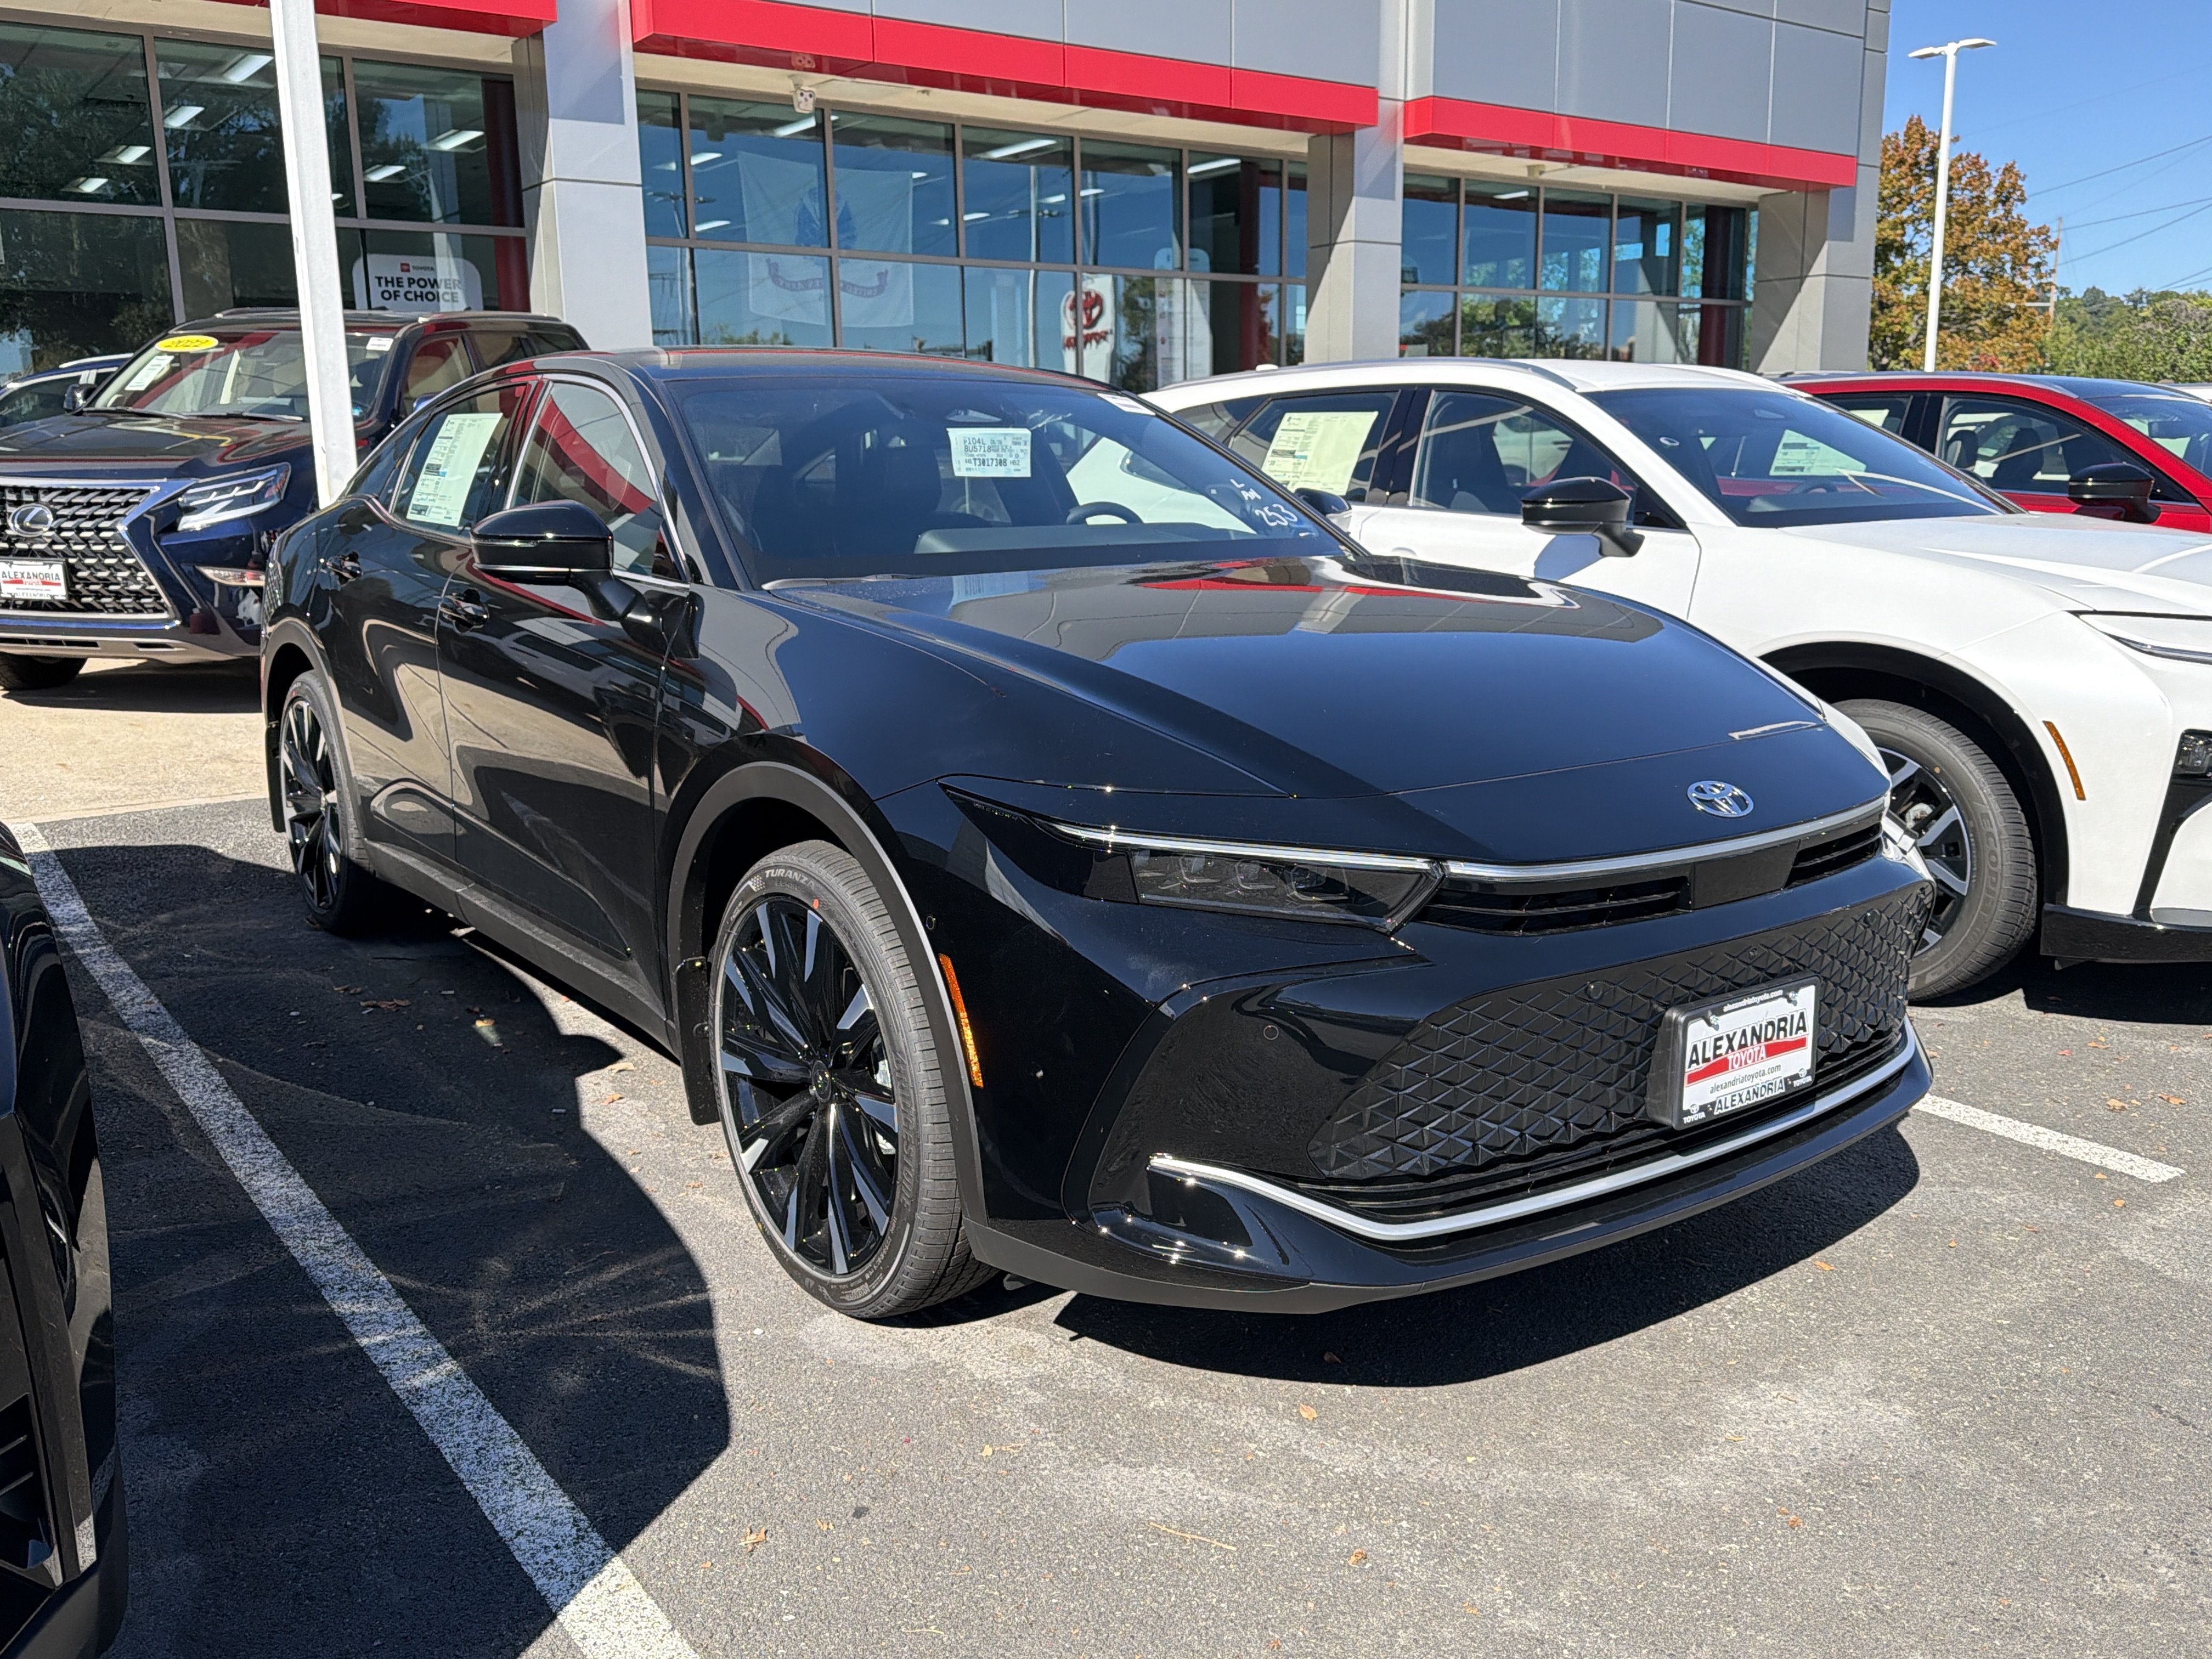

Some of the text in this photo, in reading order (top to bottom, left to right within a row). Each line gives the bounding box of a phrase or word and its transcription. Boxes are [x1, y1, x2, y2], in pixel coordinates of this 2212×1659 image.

[375, 276, 461, 290] THE POWER
[381, 289, 459, 303] OF CHOICE
[1255, 504, 1297, 526] 253
[2, 571, 60, 580] ALEXANDRIA
[765, 868, 816, 890] TURANZA
[1688, 1012, 1807, 1069] ALEXANDRIA
[1728, 1045, 1766, 1070] TOYOTA
[1710, 1064, 1781, 1094] alexandriatoyota.com
[1793, 1075, 1812, 1087] TOYOTA
[1715, 1079, 1784, 1114] ALEXANDRIA
[1683, 1111, 1706, 1124] TOYOTA
